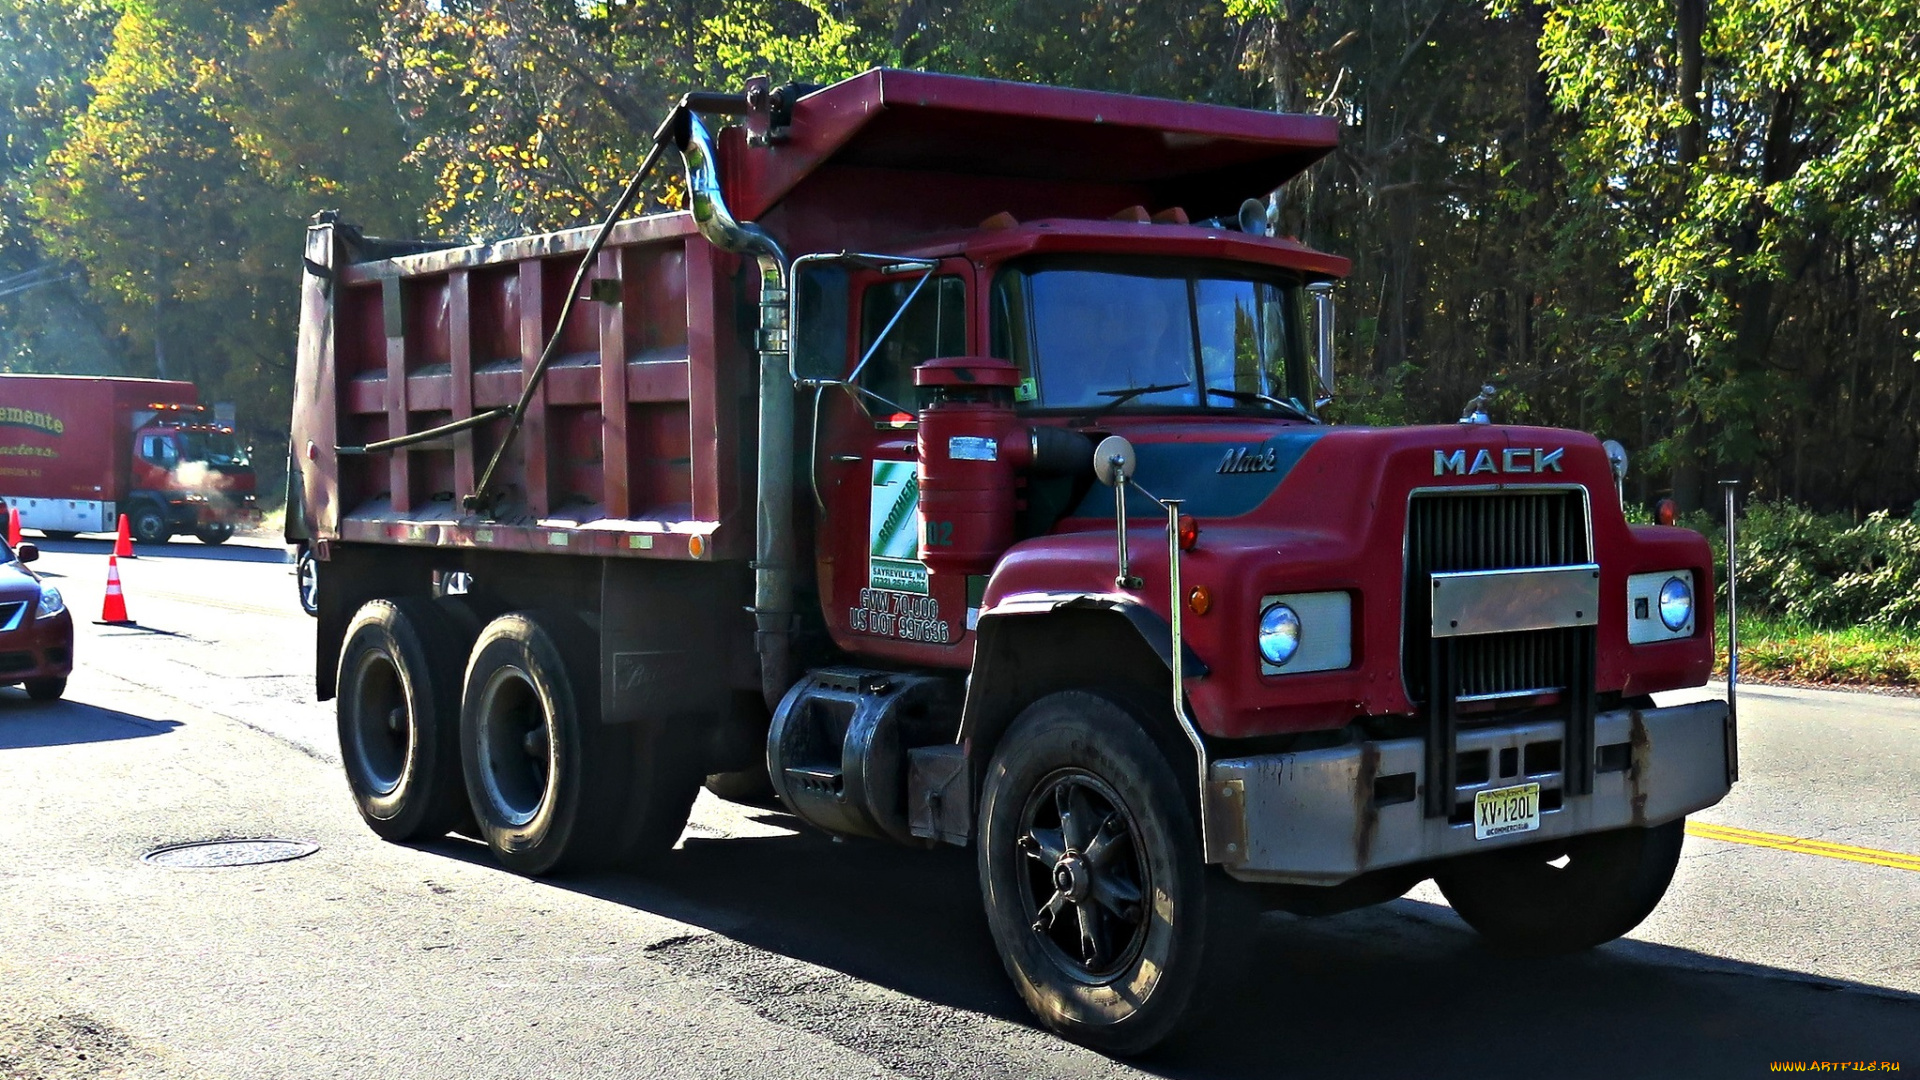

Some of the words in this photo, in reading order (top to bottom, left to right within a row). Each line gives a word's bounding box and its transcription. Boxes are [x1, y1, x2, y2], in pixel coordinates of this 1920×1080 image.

[1215, 446, 1275, 473] Mack
[1433, 446, 1564, 476] MACK
[878, 470, 919, 544] BROTHERS
[860, 588, 890, 613] GVW
[850, 606, 868, 631] US
[870, 610, 896, 636] DOT
[898, 616, 949, 643] 997636
